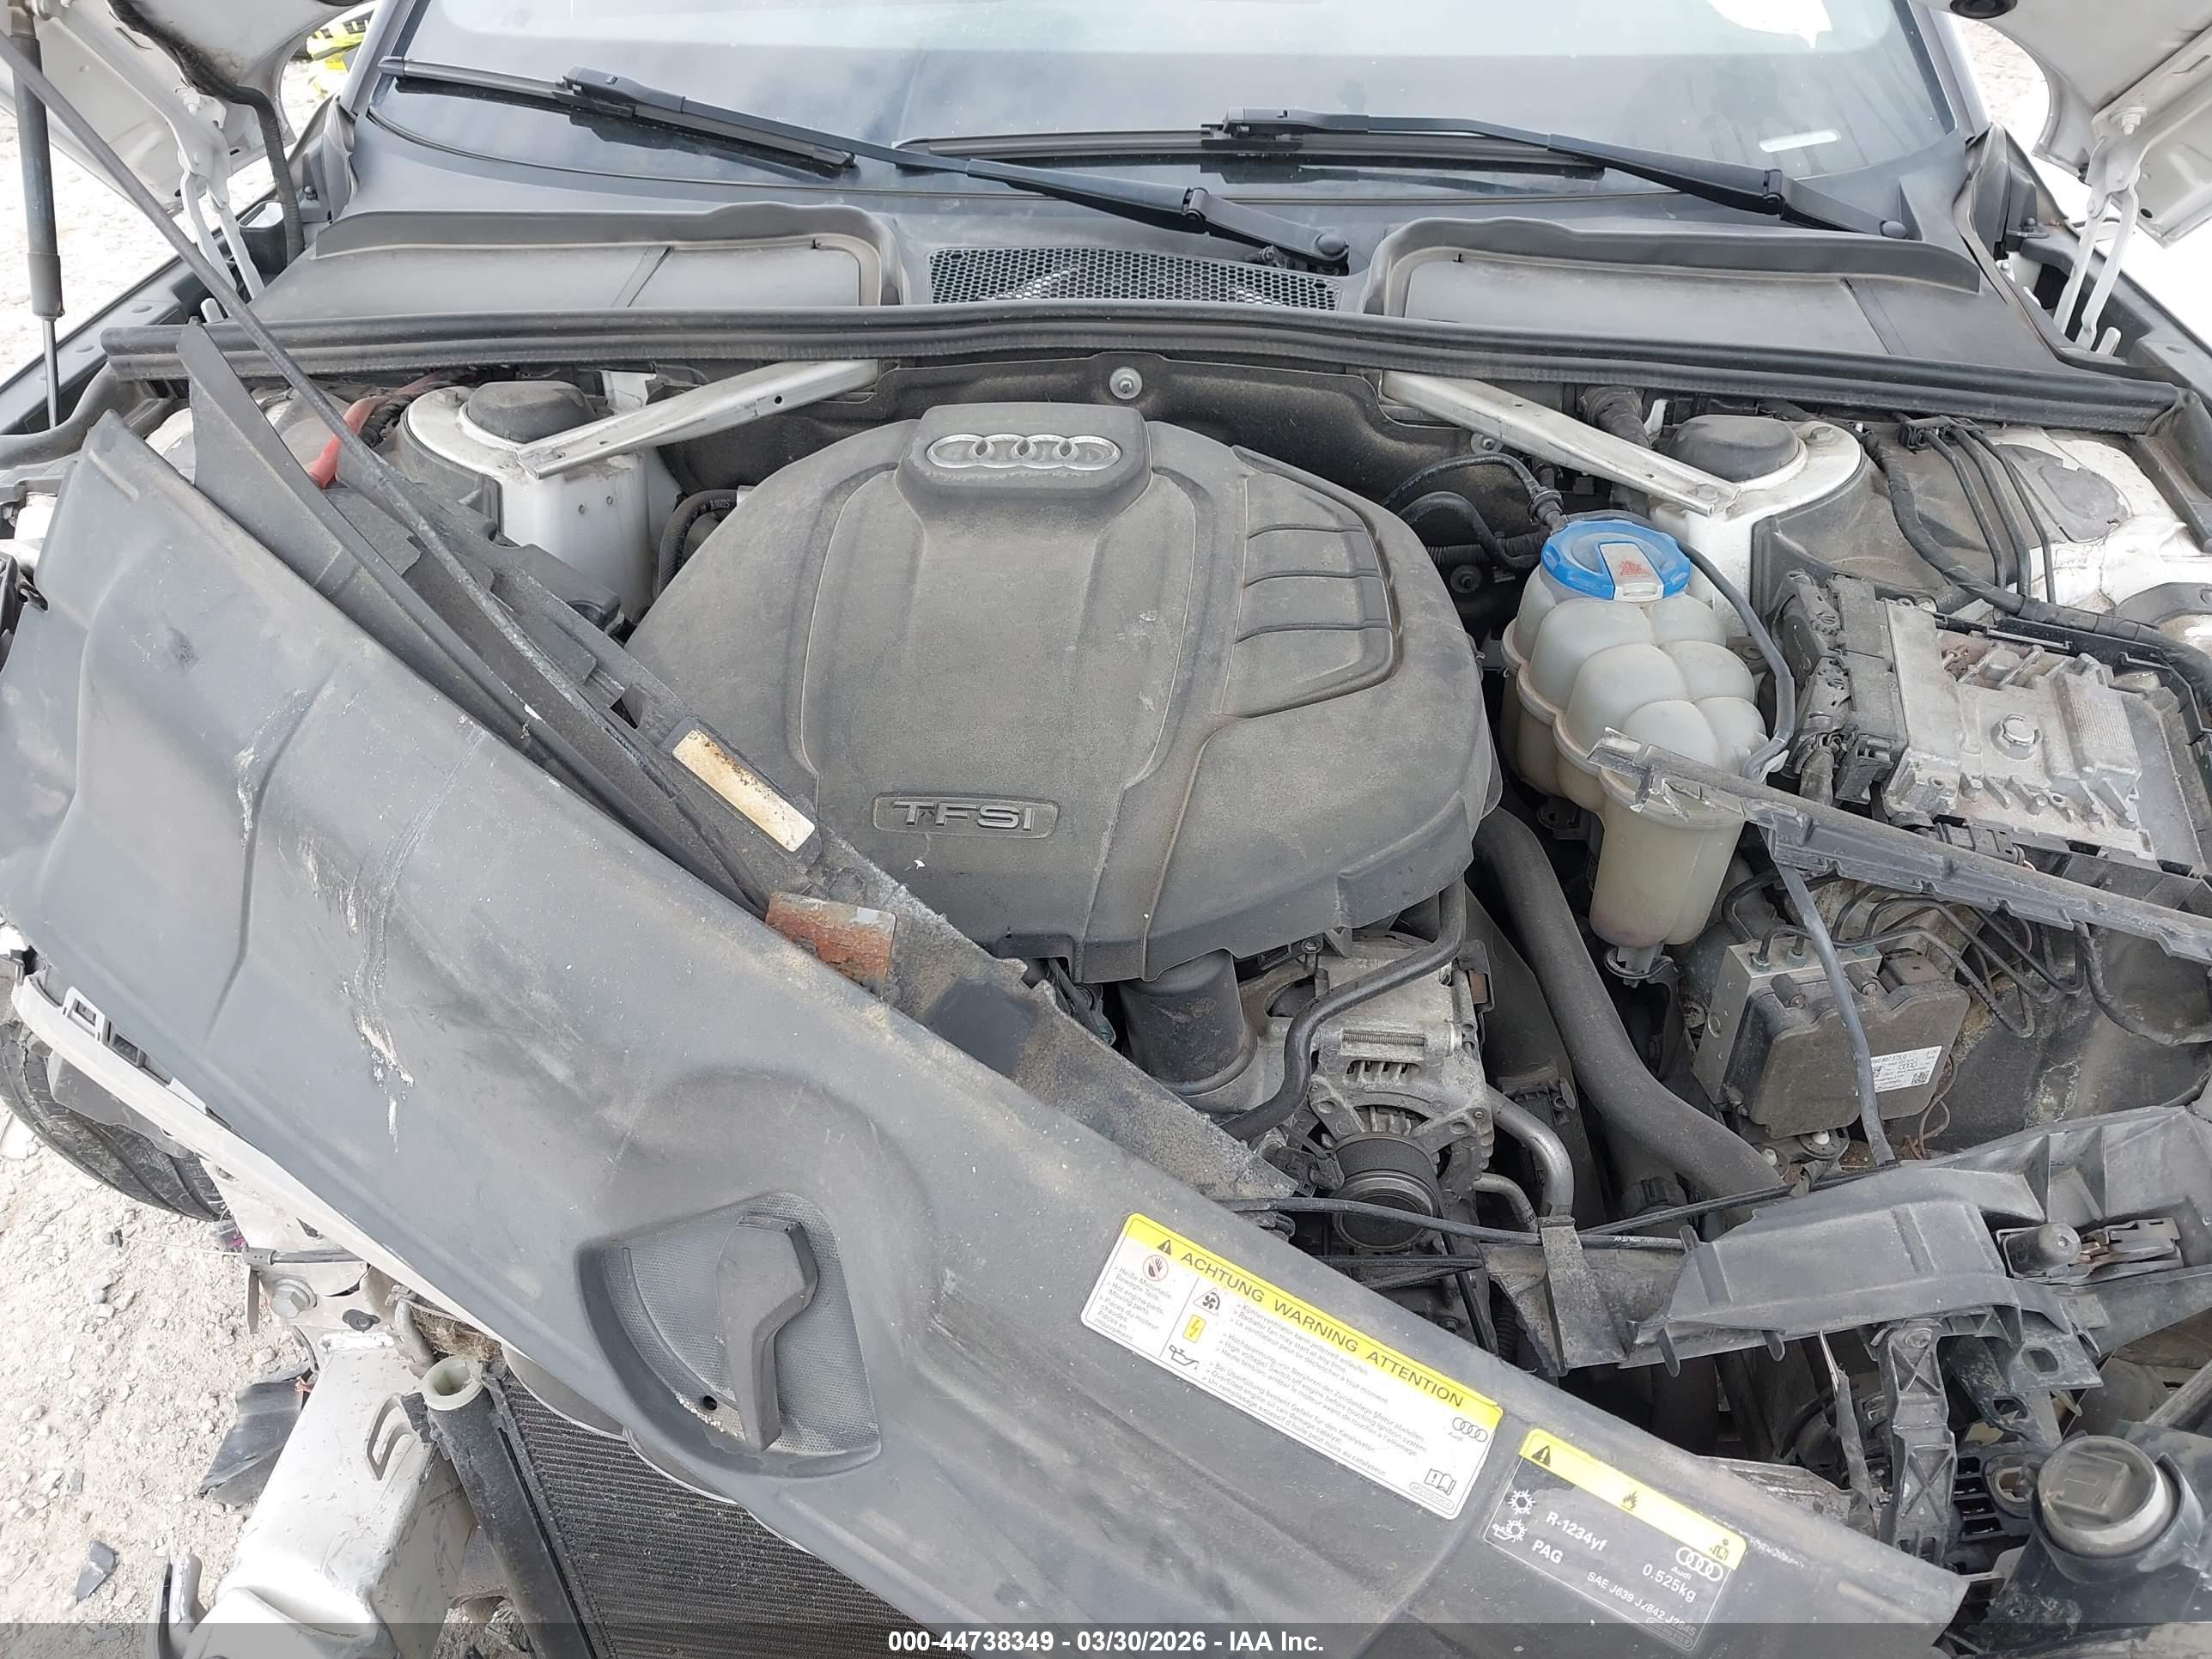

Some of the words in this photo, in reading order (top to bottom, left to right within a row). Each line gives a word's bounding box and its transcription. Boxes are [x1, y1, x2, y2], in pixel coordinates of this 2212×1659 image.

[893, 801, 1034, 831] TFSI
[1111, 1281, 1124, 1291] Hot
[1123, 1289, 1147, 1305] engine
[1115, 1273, 1144, 1291] Bewegte
[1108, 1288, 1133, 1307] Moving
[1180, 1252, 1265, 1303] ACHTUNG
[1273, 1298, 1358, 1352] WARNING
[1365, 1351, 1464, 1407] ATTENTION
[1238, 1310, 1267, 1329] Radiator
[1267, 1326, 1278, 1336] fan
[1279, 1334, 1293, 1346] may
[1294, 1342, 1310, 1354] start
[1317, 1354, 1330, 1365] any
[1278, 1343, 1295, 1354] peut
[1207, 1376, 1218, 1387] Un
[1220, 1348, 1240, 1363] Haute
[1297, 1390, 1322, 1406] moteur
[1224, 1340, 1240, 1352] High
[1268, 1364, 1291, 1381] Switch
[1291, 1377, 1302, 1386] off
[1301, 1383, 1324, 1398] engine
[1324, 1395, 1346, 1410] before
[1214, 1362, 1226, 1372] Bei
[1265, 1389, 1291, 1407] besteht
[1290, 1402, 1314, 1419] Gefahr
[1243, 1389, 1267, 1403] engine
[1266, 1400, 1276, 1409] oil
[1275, 1405, 1289, 1415] can
[1372, 1410, 1395, 1425] Motor
[1545, 1510, 1608, 1552] R-1234yf
[1642, 1563, 1697, 1603] 0.525kg
[1670, 1565, 1692, 1581] Audi
[1531, 1539, 1564, 1564] PAG
[1586, 1571, 1609, 1589] SAE
[1608, 1584, 1635, 1602] J639
[1633, 1598, 1666, 1620] J2842
[1664, 1614, 1695, 1636] J2845
